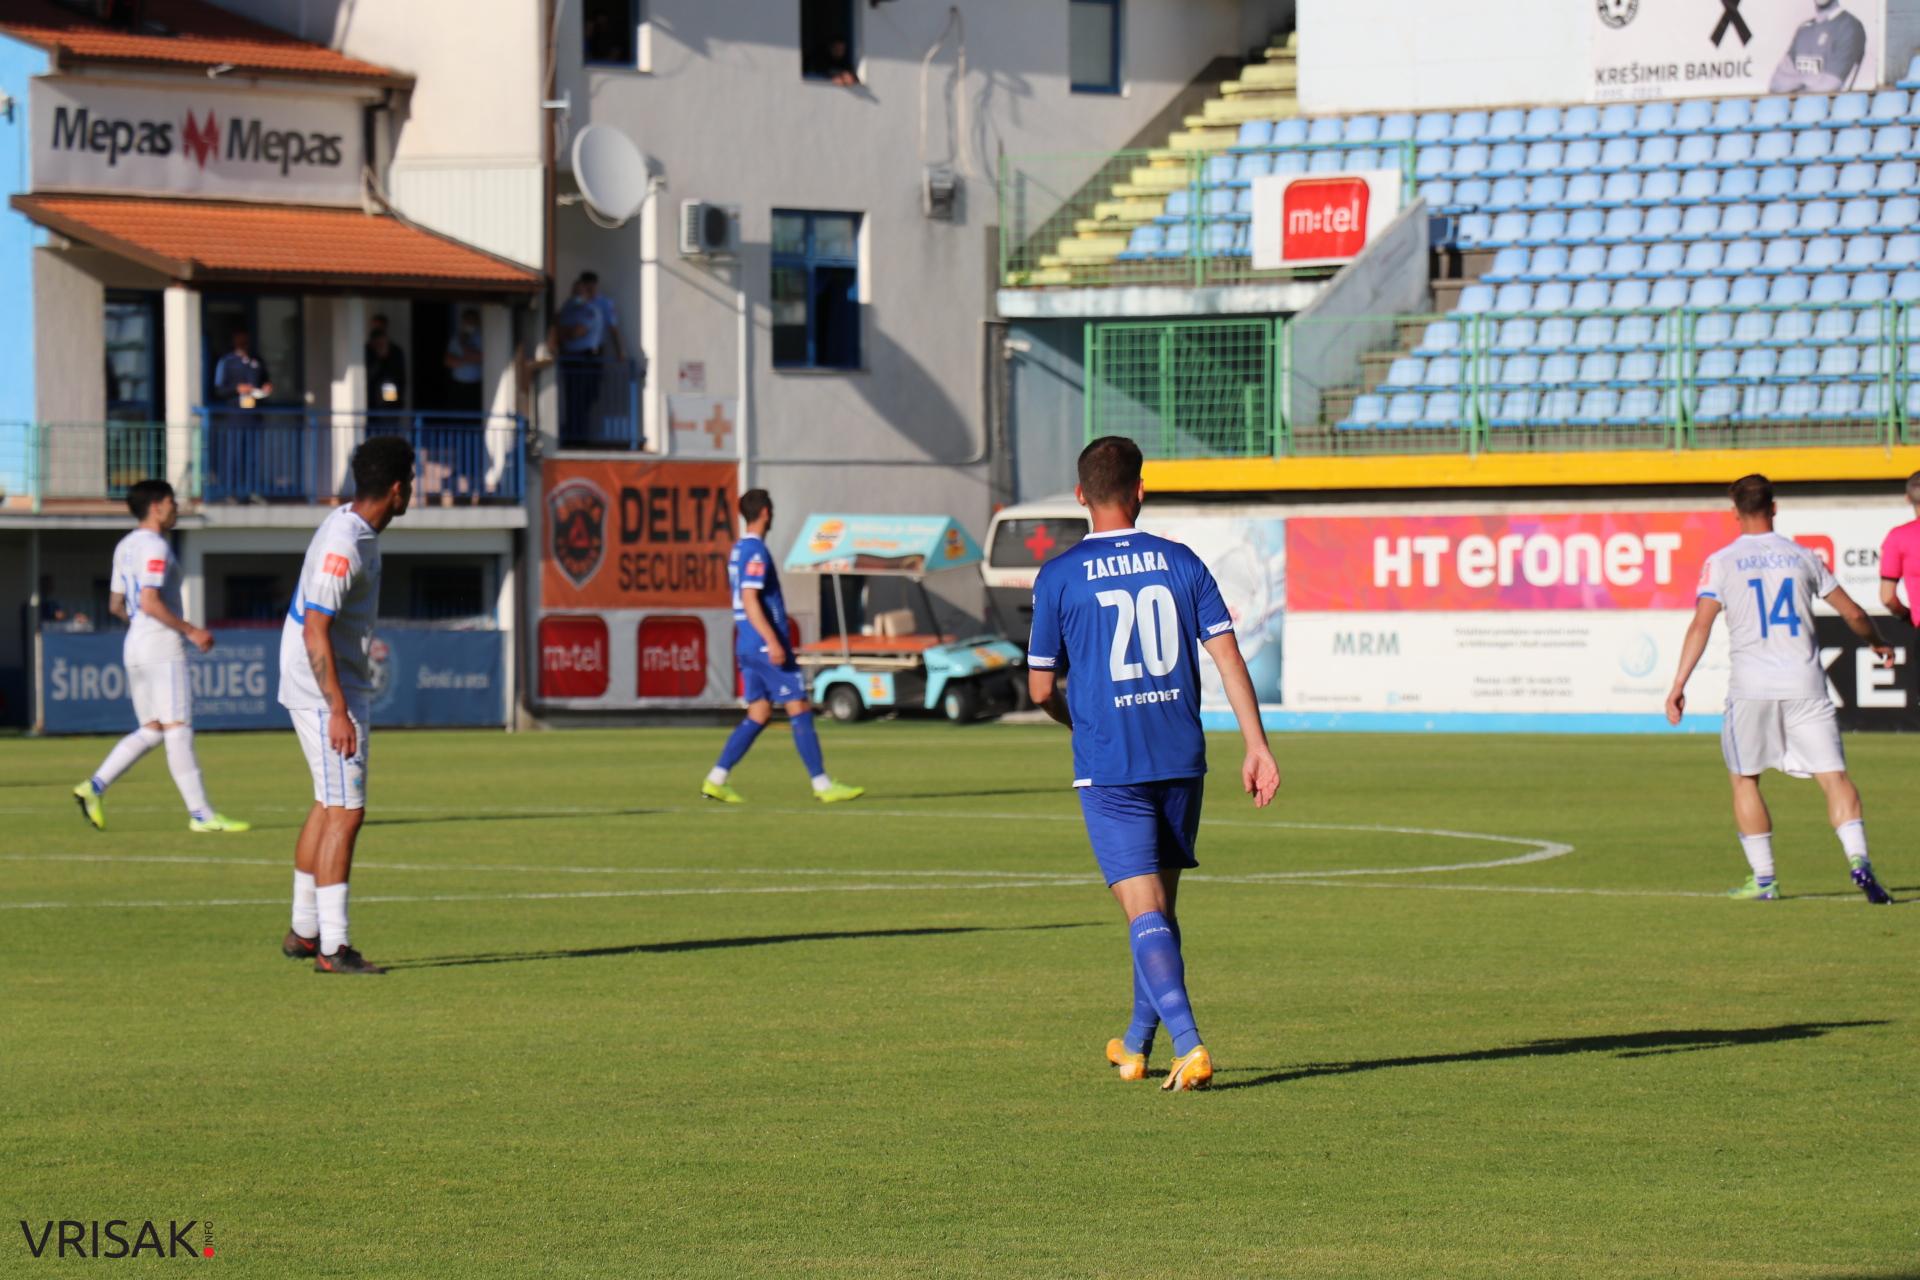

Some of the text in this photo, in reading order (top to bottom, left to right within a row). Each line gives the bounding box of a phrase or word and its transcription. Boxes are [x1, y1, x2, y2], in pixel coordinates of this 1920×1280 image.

[1595, 56, 1752, 85] KREŠIMIR BANDIĆ
[52, 106, 343, 176] Mepas Mepas
[1289, 198, 1360, 234] m:tel
[621, 487, 734, 544] DELTA
[1083, 552, 1168, 581] ZACHARA
[1373, 536, 1449, 587] HT
[1748, 577, 1802, 639] 14
[1095, 584, 1179, 681] 20
[1332, 631, 1400, 656] MRM
[543, 636, 700, 672] m:tel m:tel
[52, 657, 267, 701] ŠIRO RIJEG
[1114, 694, 1133, 708] HT
